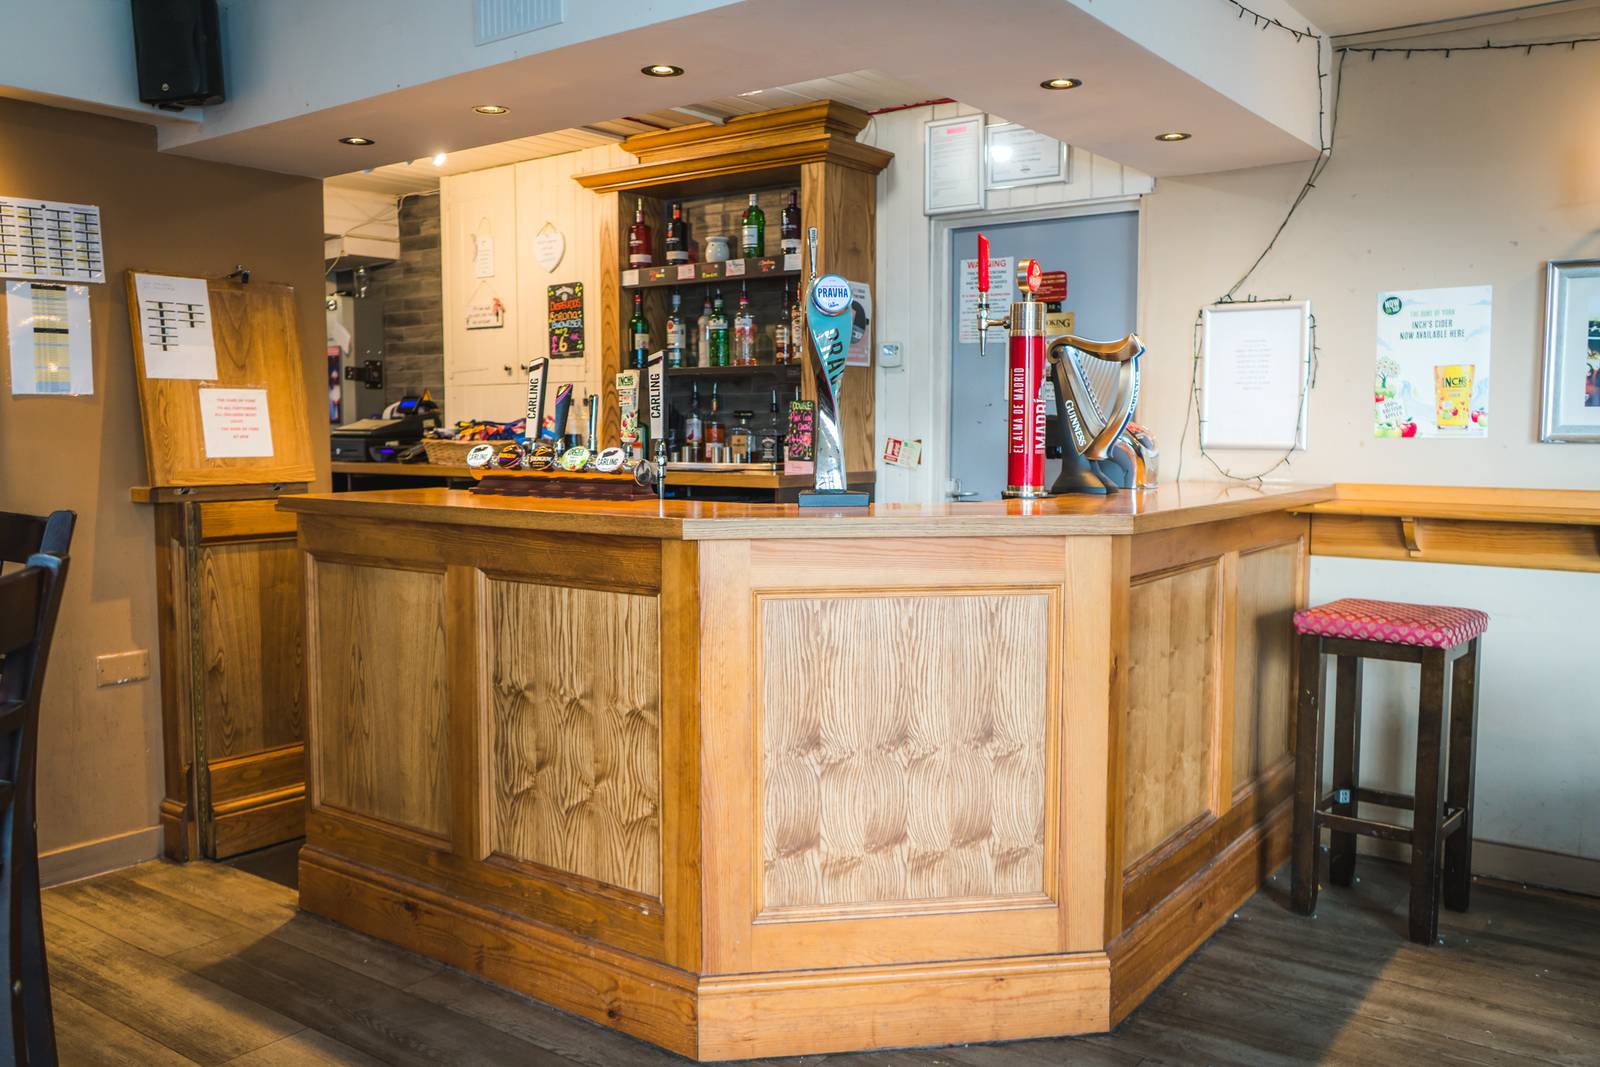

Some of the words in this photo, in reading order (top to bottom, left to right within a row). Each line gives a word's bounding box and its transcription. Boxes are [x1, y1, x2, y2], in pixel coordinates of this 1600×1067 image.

[967, 260, 1007, 269] WAING
[818, 287, 848, 298] PRAVHA
[1046, 319, 1071, 328] OKING
[1411, 320, 1433, 329] INCH'S
[1435, 319, 1453, 328] CIDER
[1400, 331, 1414, 340] NOW
[1416, 330, 1447, 340] AVAILABLE
[1449, 328, 1465, 338] HERE
[1013, 367, 1025, 401] MADRID
[527, 378, 539, 419] CARLING
[650, 373, 661, 418] CARLING
[1013, 404, 1024, 415] DE
[1065, 400, 1086, 447] GUINNESS
[1012, 418, 1024, 442] ALMA
[1013, 443, 1024, 453] EL
[597, 457, 619, 465] CARLING
